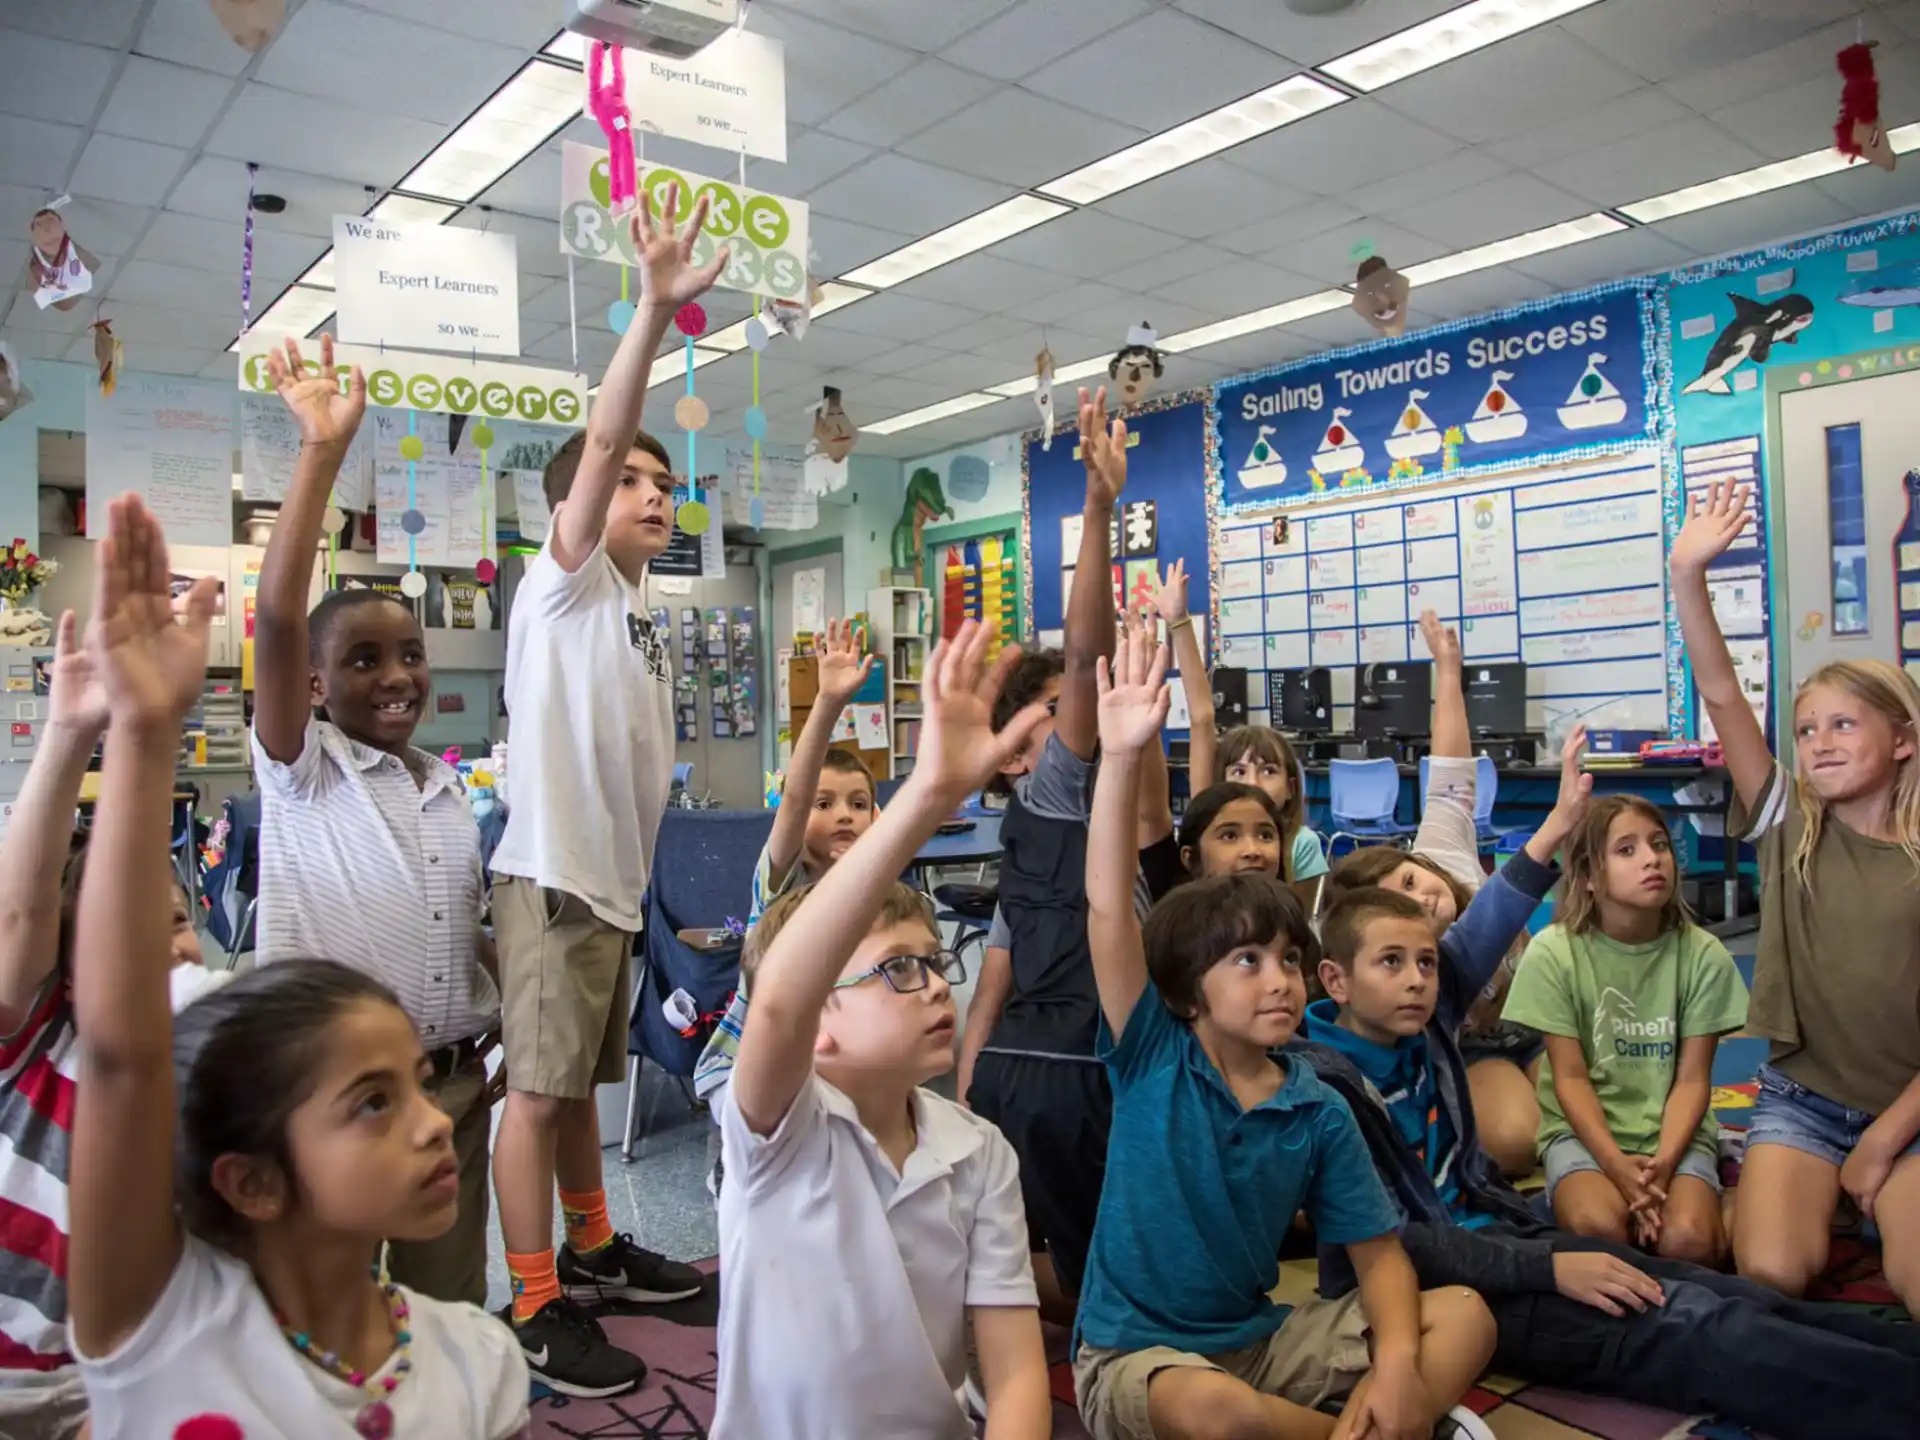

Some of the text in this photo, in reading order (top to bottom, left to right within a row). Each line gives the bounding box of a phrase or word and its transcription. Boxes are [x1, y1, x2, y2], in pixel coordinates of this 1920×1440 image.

[651, 62, 748, 97] Expert Learners
[697, 115, 712, 127] so
[714, 118, 731, 131] we
[345, 222, 402, 242] We are
[379, 270, 499, 296] Expert Learners
[438, 323, 454, 335] so
[458, 325, 479, 338] we
[1241, 314, 1608, 421] Sailing Towards Success
[1615, 1038, 1674, 1060] Camp
